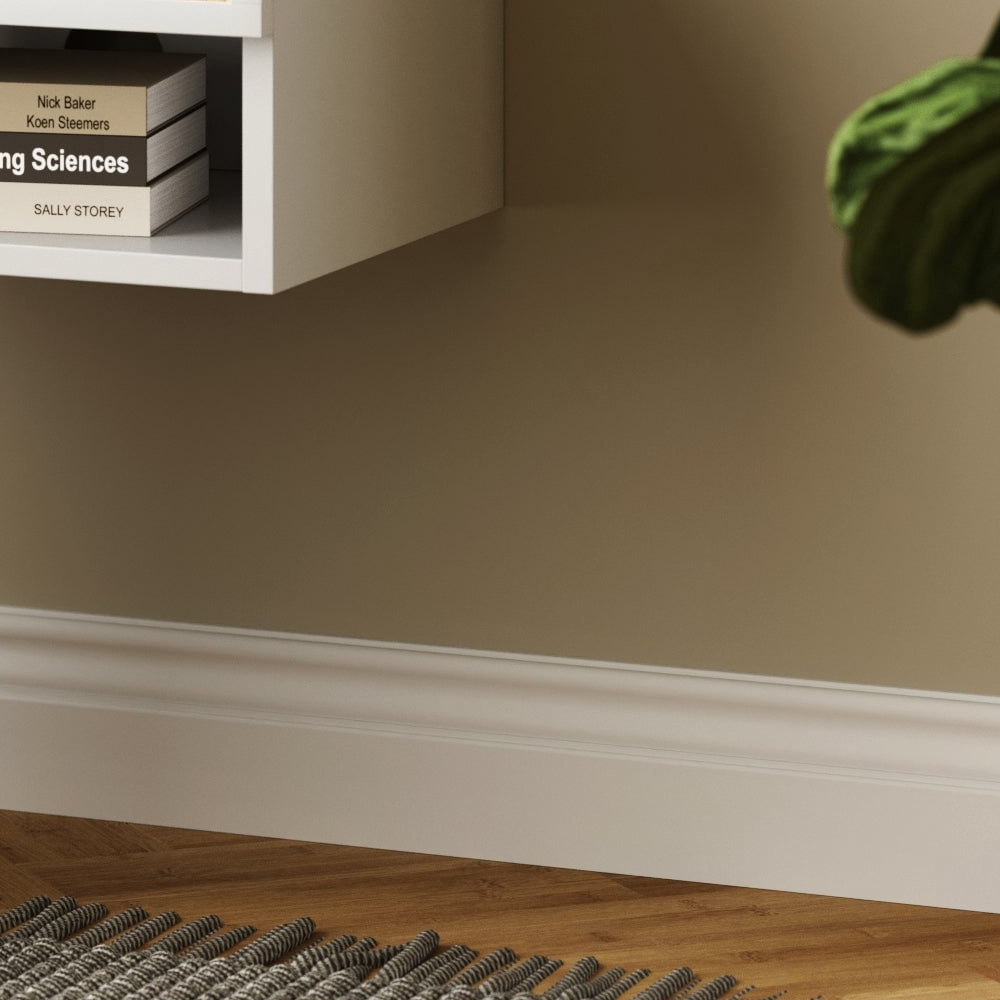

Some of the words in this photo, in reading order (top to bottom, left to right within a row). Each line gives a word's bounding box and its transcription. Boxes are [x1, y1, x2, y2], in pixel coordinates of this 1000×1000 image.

[37, 94, 60, 109] Nick
[63, 95, 96, 111] Baker
[26, 114, 54, 129] Koen
[58, 115, 110, 131] Steemers
[31, 148, 129, 173] Sciences
[33, 203, 70, 216] SALLY
[74, 204, 123, 218] STOREY
